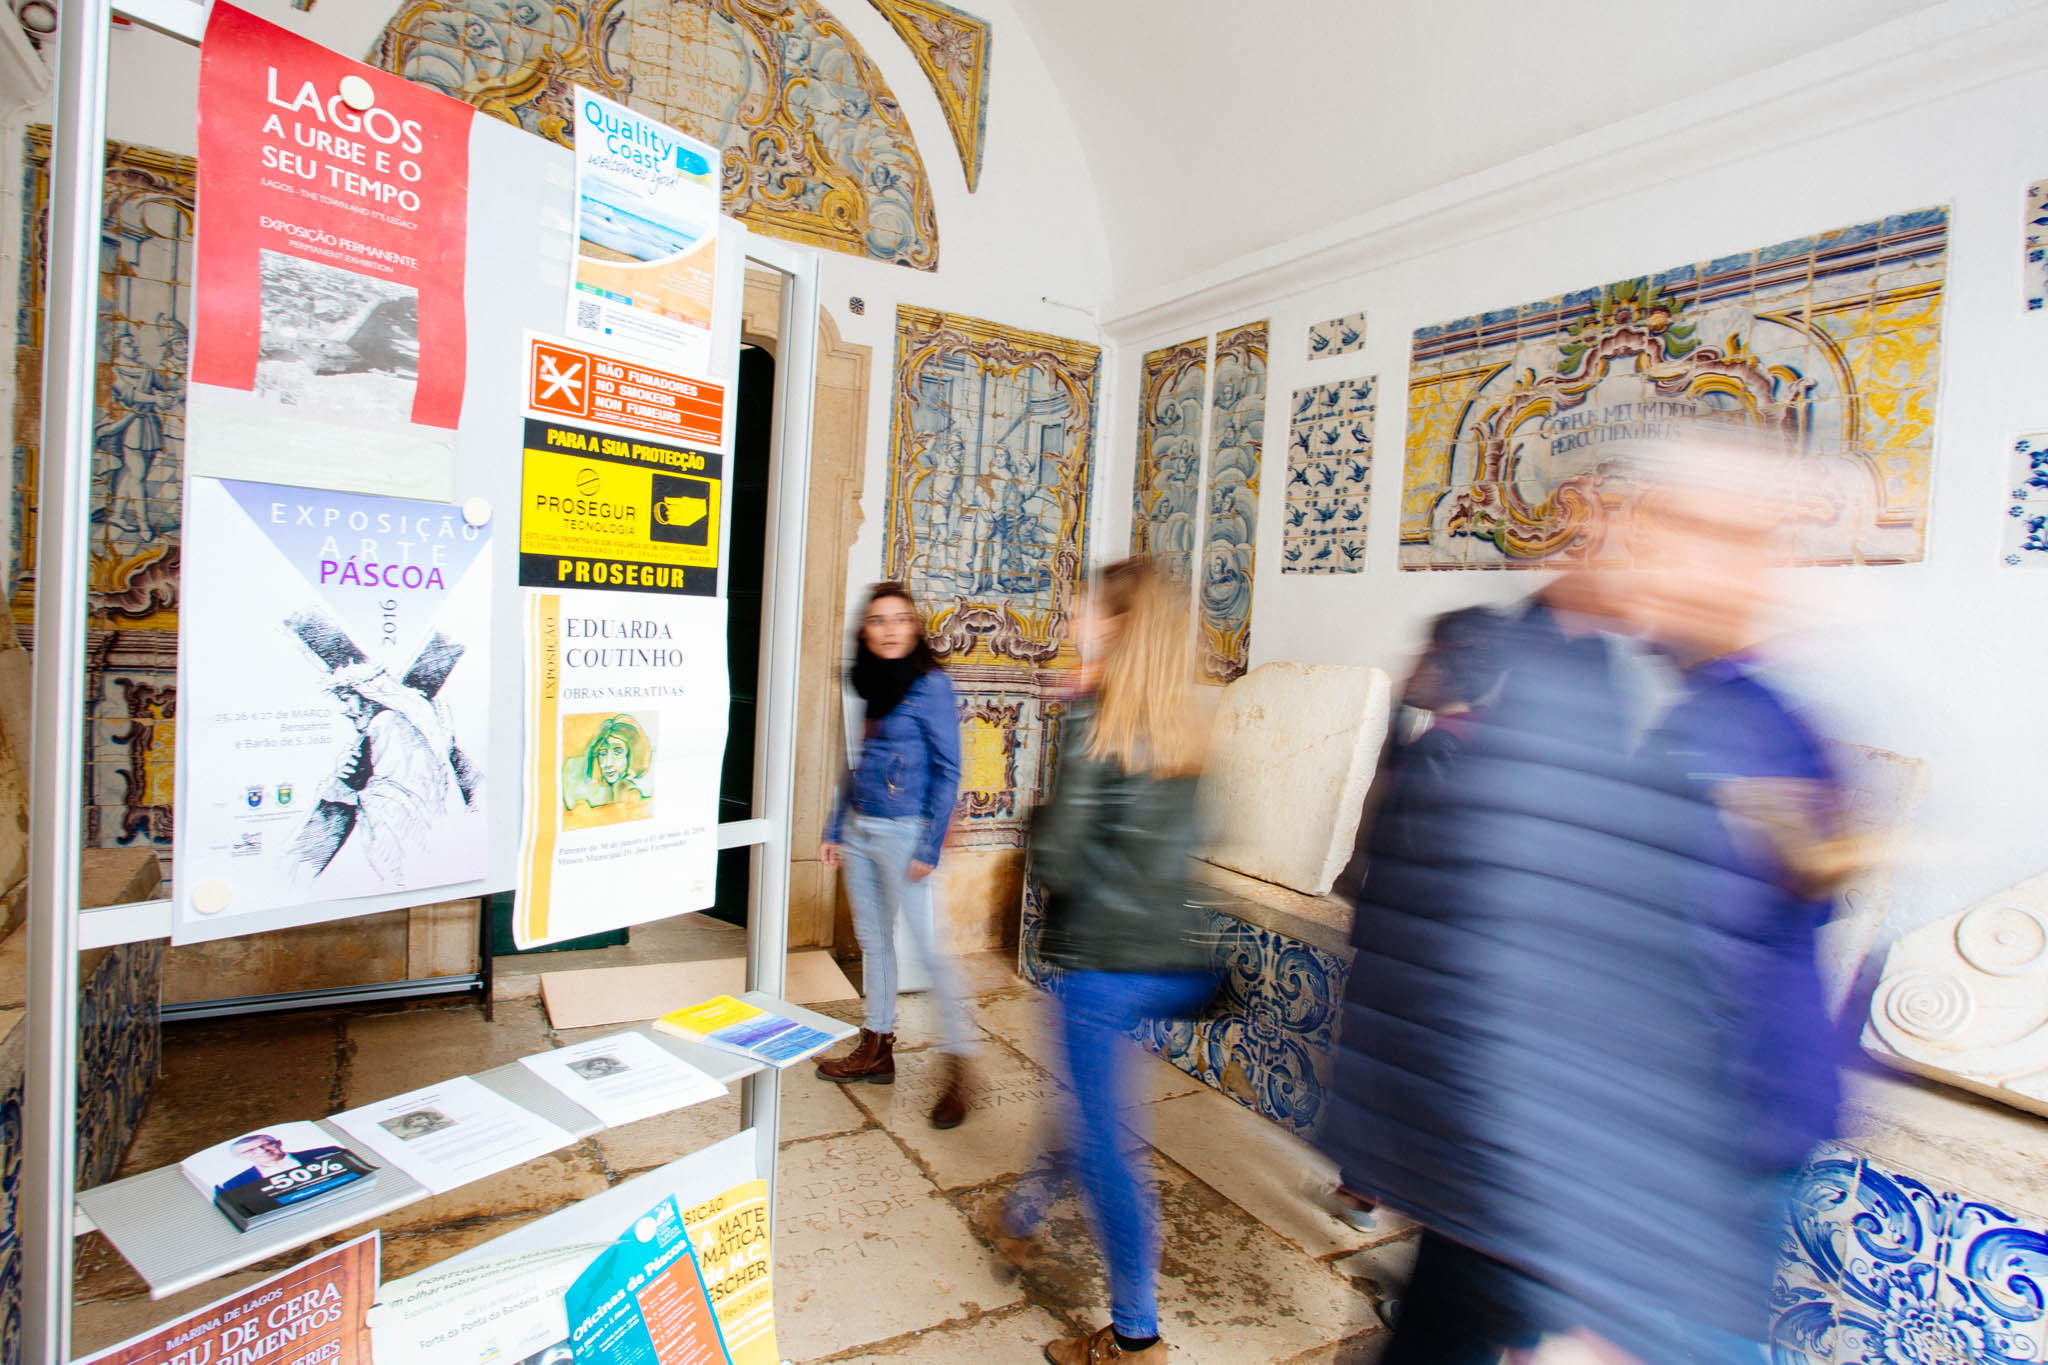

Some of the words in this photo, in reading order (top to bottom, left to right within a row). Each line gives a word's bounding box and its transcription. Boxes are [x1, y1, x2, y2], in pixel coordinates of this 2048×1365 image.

[268, 66, 423, 154] LAGOS
[262, 114, 286, 139] A
[294, 122, 366, 165] URBE
[375, 150, 391, 174] E
[398, 160, 421, 182] O
[585, 100, 673, 160] Quality
[606, 134, 660, 173] Coast
[261, 145, 317, 179] SEU
[324, 164, 421, 211] TEMPO
[301, 189, 319, 201] THE
[259, 215, 338, 247] EXPOSIÇÃO
[338, 237, 419, 270] PERMANENTE
[595, 379, 615, 393] NO
[618, 384, 676, 407] SMOKERS
[596, 362, 624, 379] NÃO
[627, 370, 699, 397] FUMADORES
[594, 395, 623, 412] NON
[625, 402, 682, 424] FUMEURS
[547, 428, 587, 453] PARA
[588, 436, 600, 453] A
[601, 438, 630, 459] SUA
[632, 443, 705, 471] PROTECÇÃO
[271, 502, 479, 543] EXPOSIÇÃO
[536, 494, 637, 522] PROSEGUR
[563, 518, 636, 535] TECNOLOGIA
[319, 535, 448, 567] ARTE
[320, 555, 446, 590] PÁSCOA
[558, 559, 685, 589] PROSEGUR
[379, 599, 398, 646] 2016
[566, 618, 673, 640] EDUARDA
[546, 616, 558, 700] EXPOSIÇÃO
[566, 648, 684, 668] COUTINHO
[563, 687, 605, 700] OBRAS
[607, 685, 686, 699] NARRATIVAS
[260, 1158, 344, 1193] -50%
[718, 1207, 765, 1240] MATE
[703, 1226, 766, 1268] MATICA
[165, 1317, 222, 1351] MARINA
[223, 1307, 241, 1324] DE
[242, 1287, 284, 1314] LAGOS
[219, 1317, 260, 1356] DE
[267, 1282, 342, 1329] CERA
[573, 1288, 626, 1341] Oficinas
[627, 1274, 645, 1291] de
